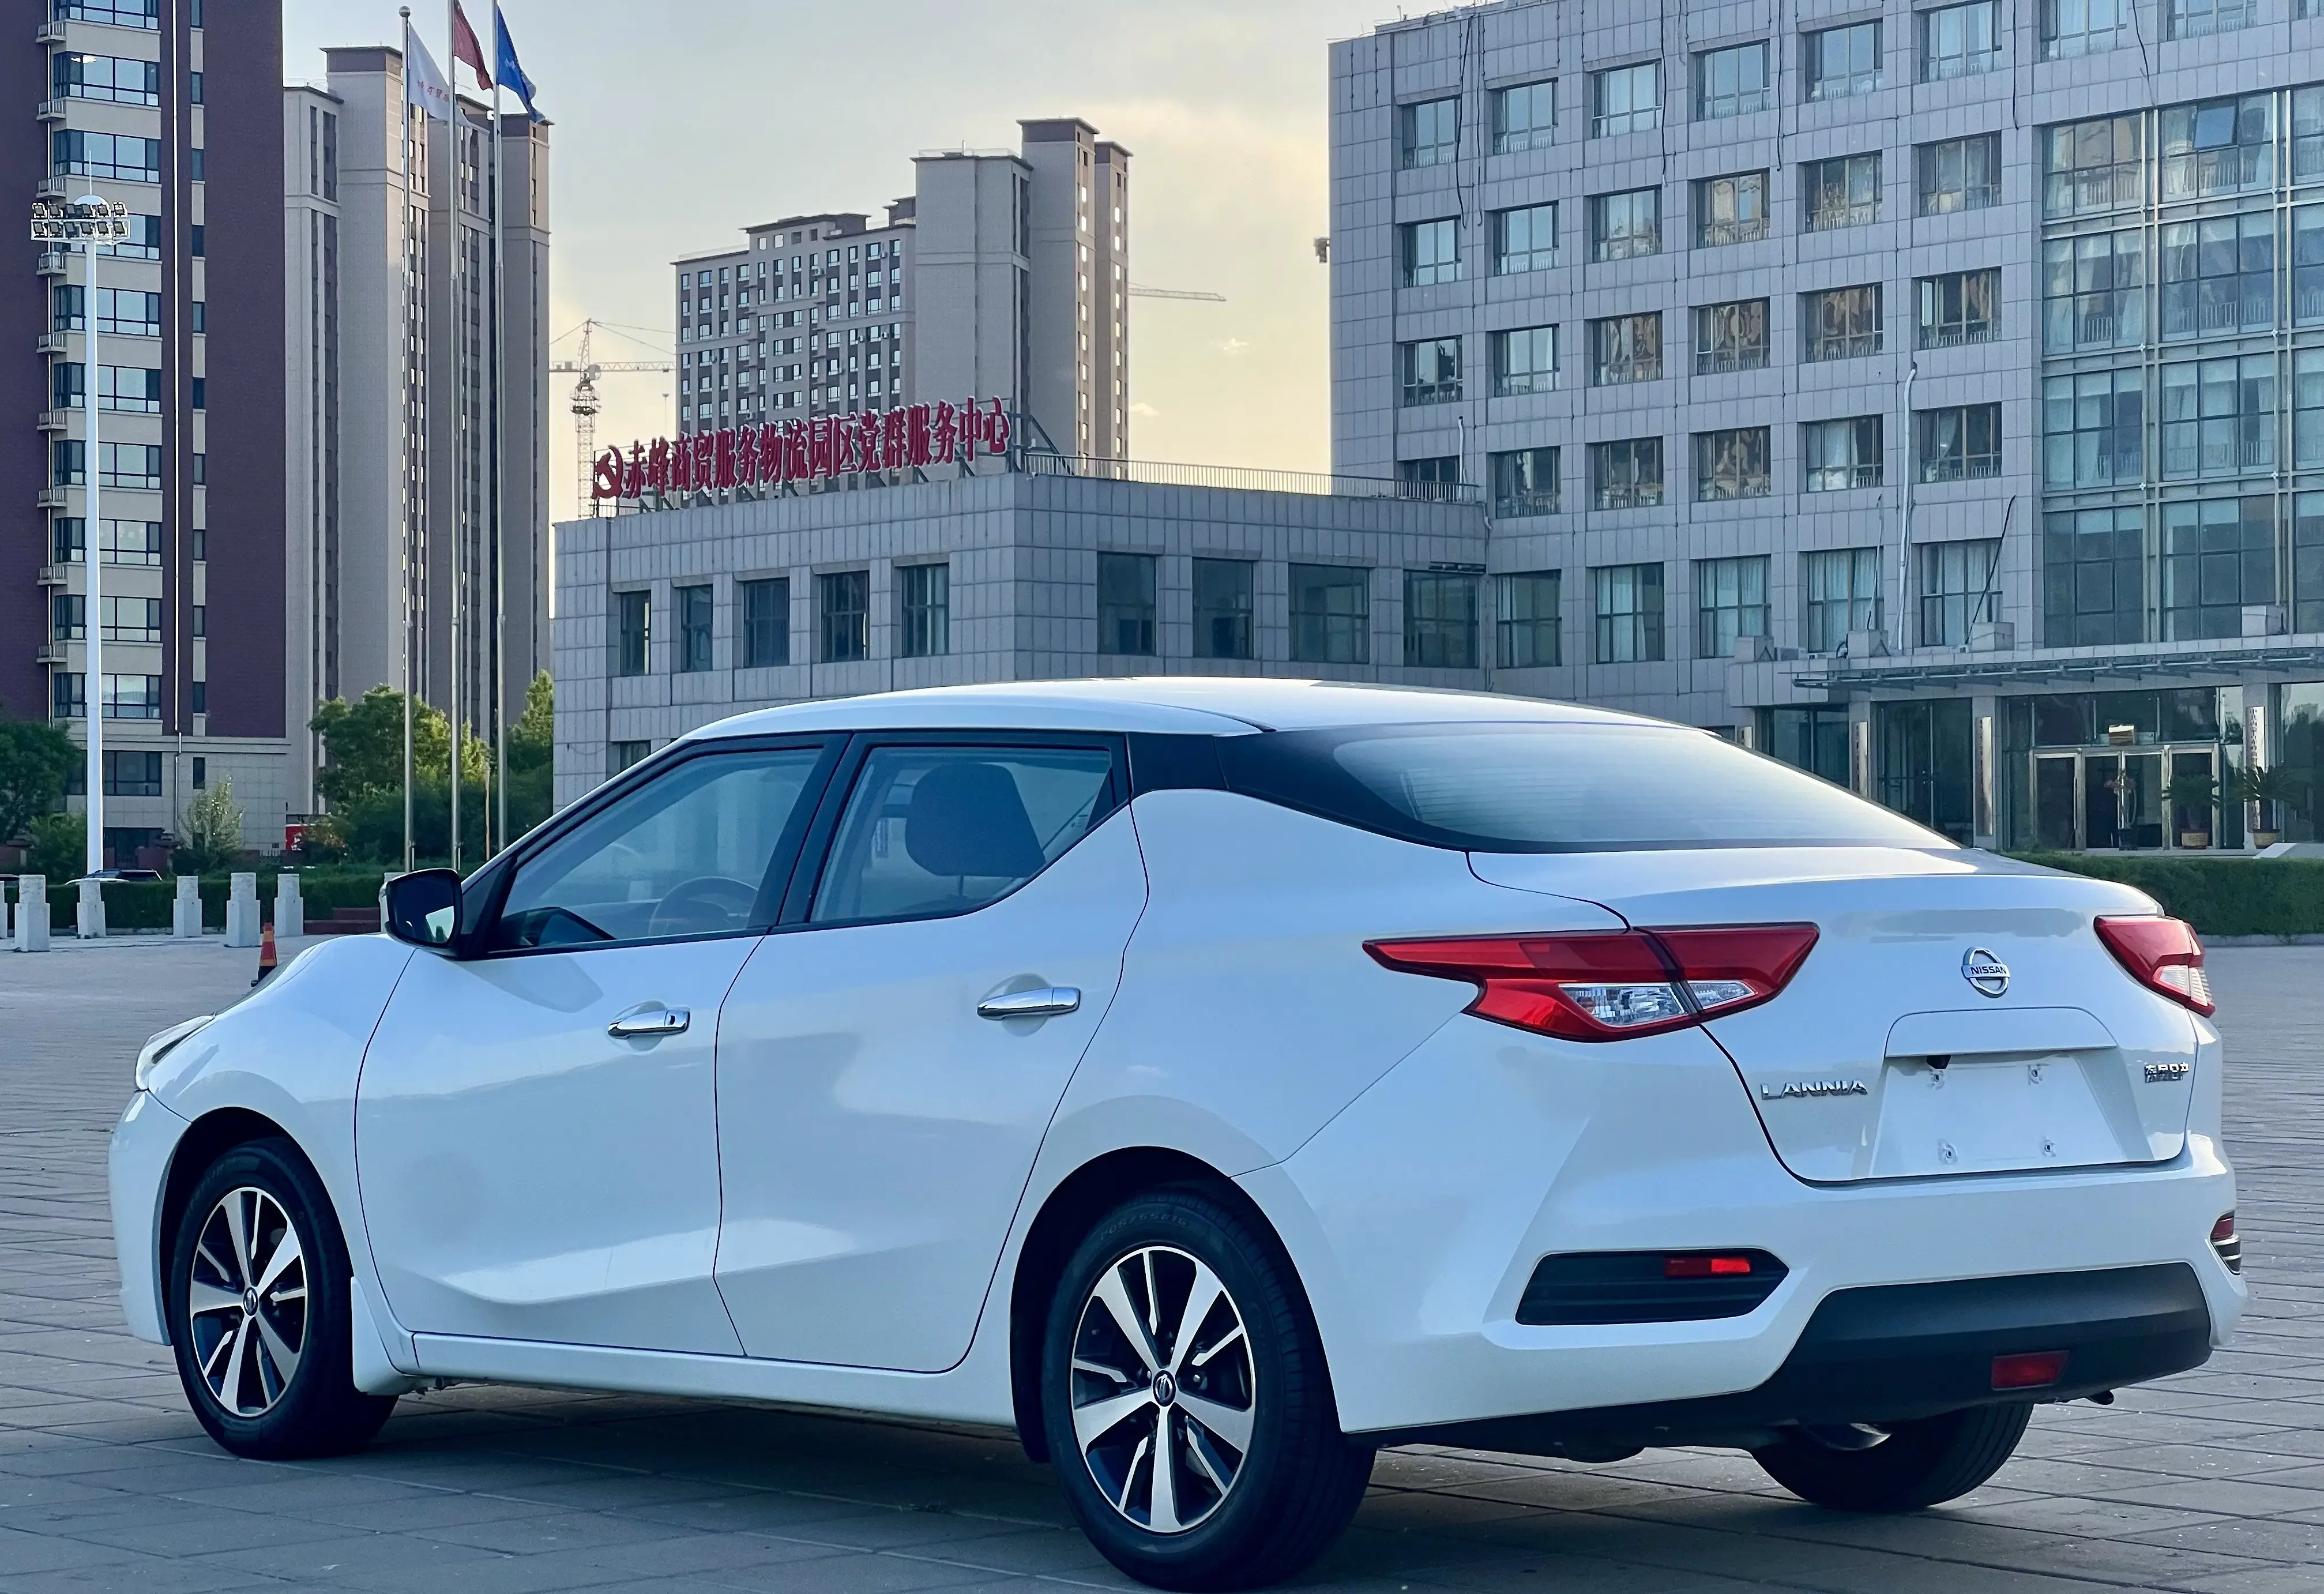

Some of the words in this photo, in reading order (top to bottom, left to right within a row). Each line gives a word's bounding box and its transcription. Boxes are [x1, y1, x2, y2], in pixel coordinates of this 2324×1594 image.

[623, 395, 1011, 499] 赤峰商贸服务物流园区党群服务中心
[1970, 965, 2007, 975] NISSAN
[1761, 1080, 1868, 1100] LANNIA
